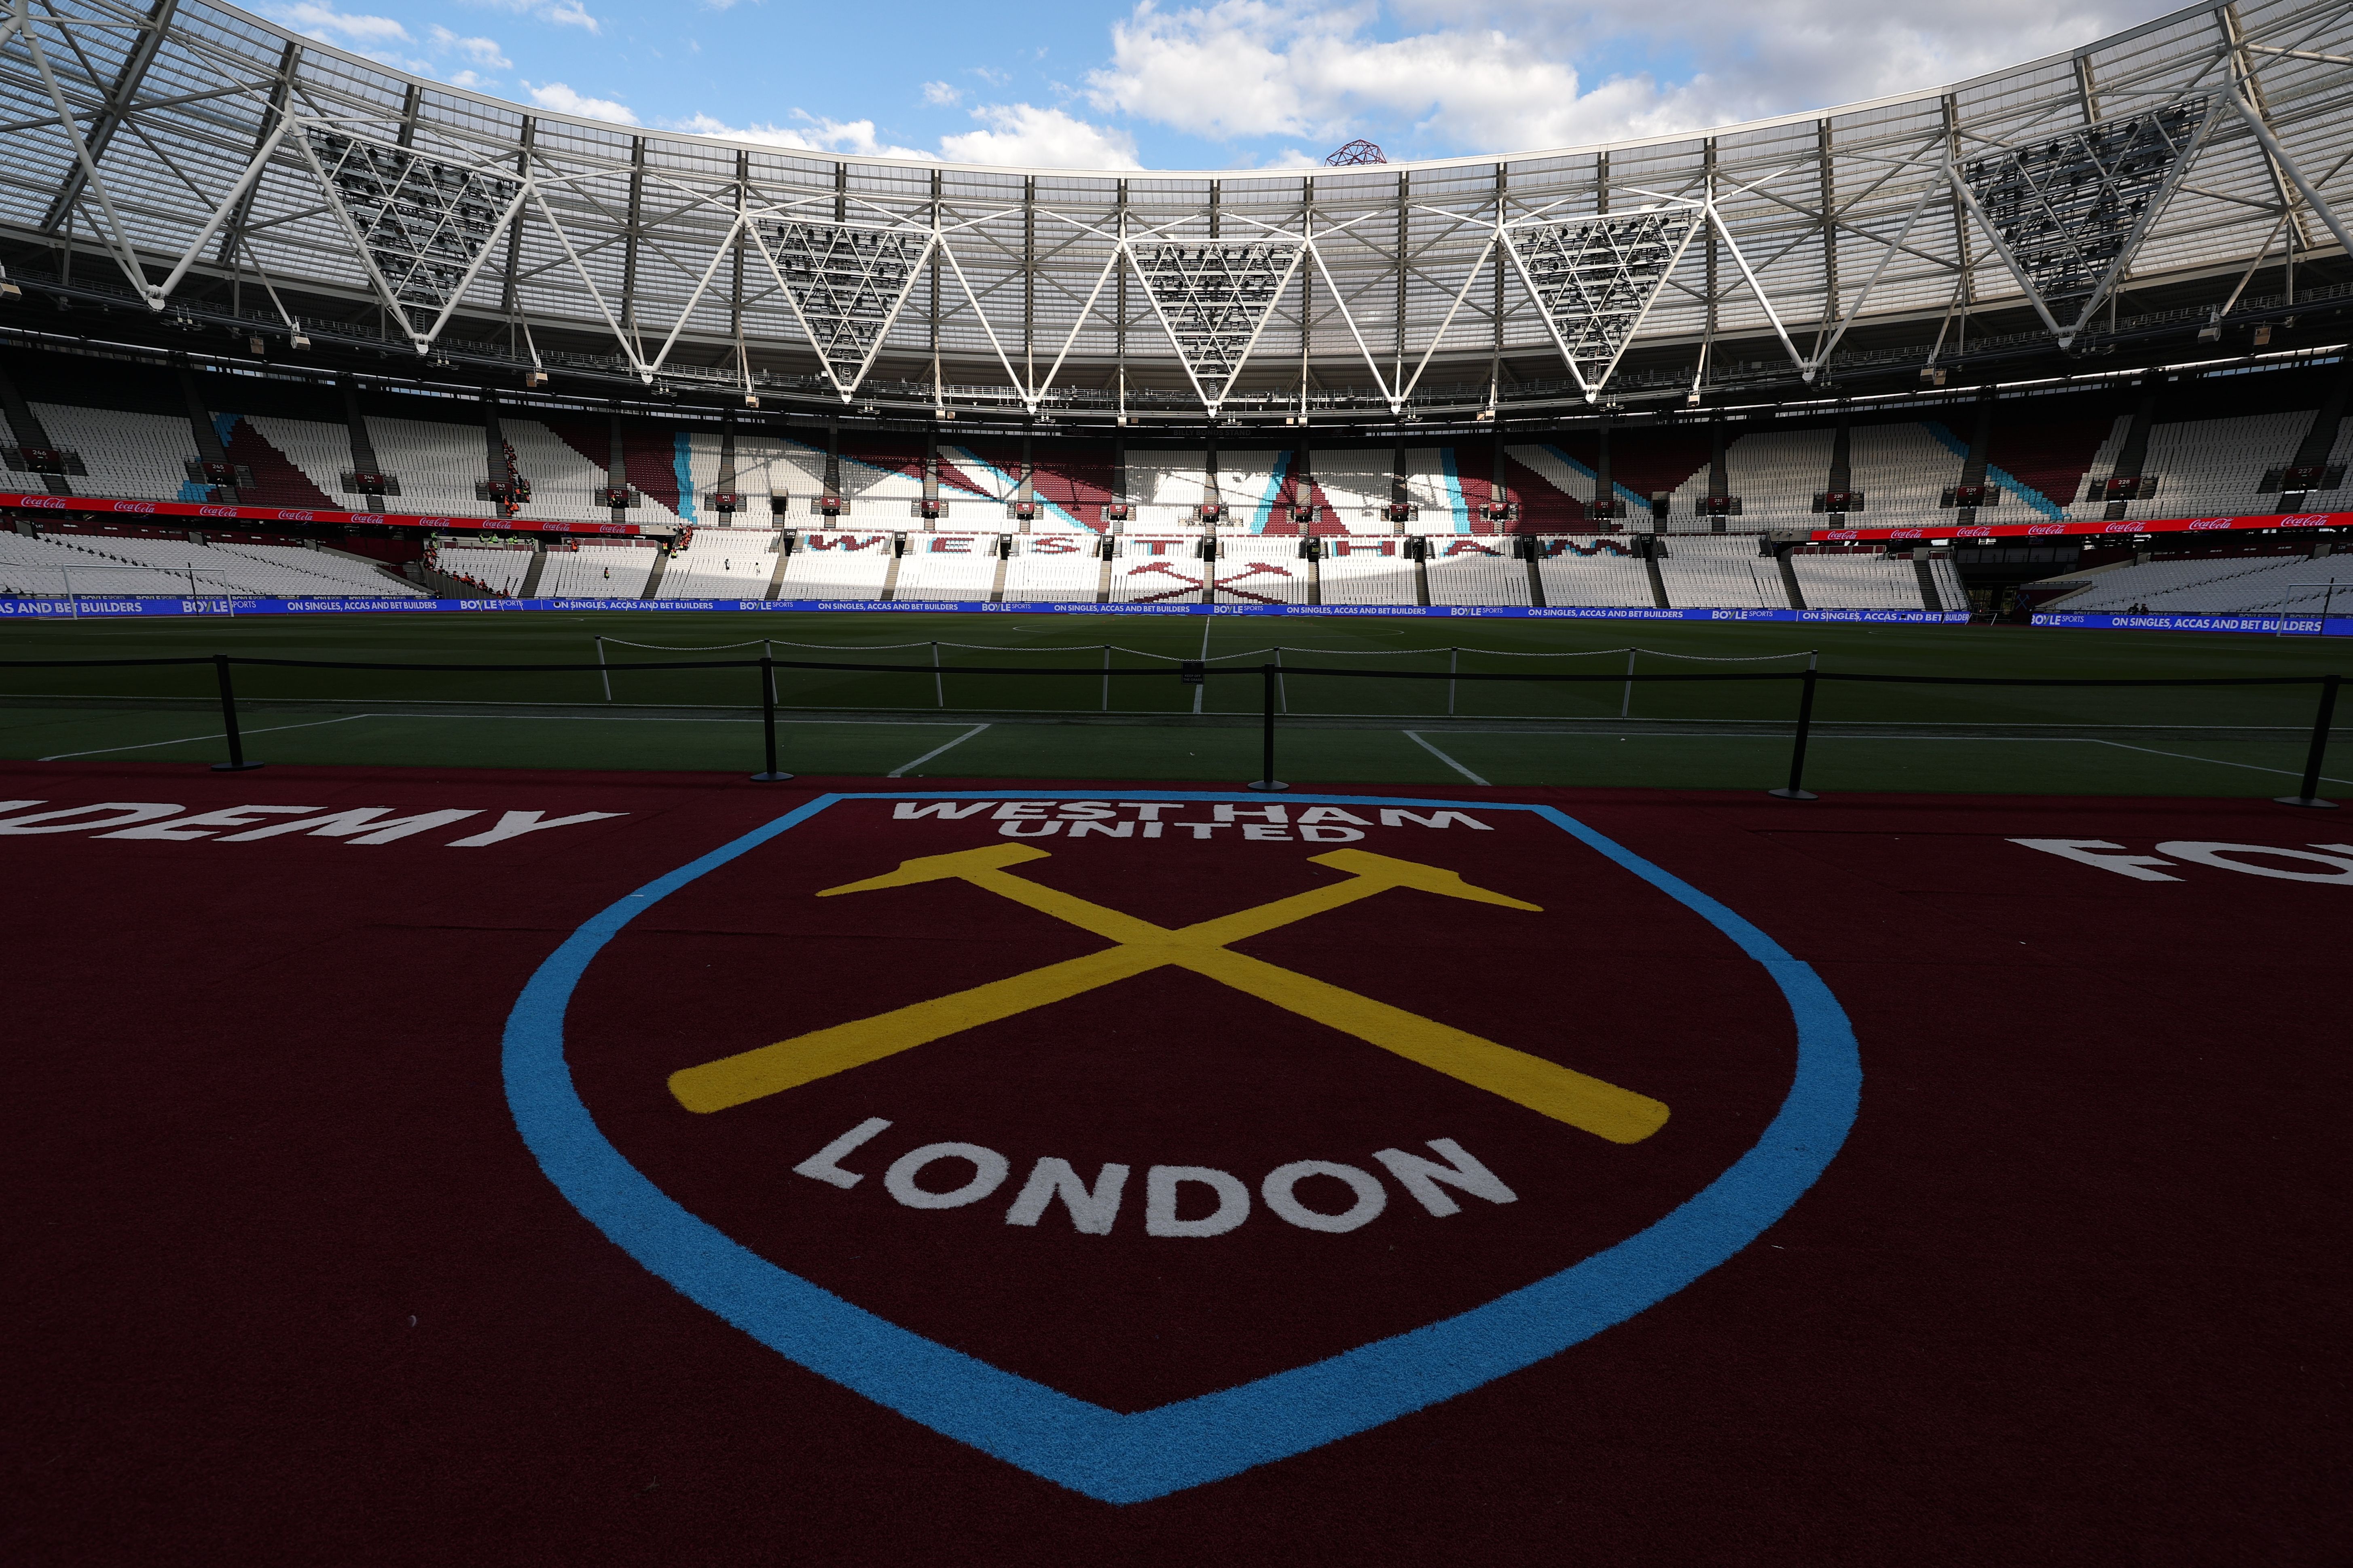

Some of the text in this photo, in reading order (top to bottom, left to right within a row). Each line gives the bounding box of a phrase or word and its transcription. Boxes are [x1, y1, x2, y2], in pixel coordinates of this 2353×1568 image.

[21, 497, 66, 508] Coca-Cola
[114, 501, 155, 513] Coca-Cola
[200, 506, 237, 517] Coca-Cola
[278, 510, 313, 521] Coca-Cola
[351, 514, 384, 524] Coca-Cola
[420, 517, 450, 527] Coca-Cola
[2189, 518, 2234, 530] Coca-Cola
[2281, 515, 2330, 527] Coca-Cola
[483, 520, 512, 529] Coca-Cola
[543, 522, 570, 531] Coca-Cola
[600, 524, 626, 533] Coca-Cola
[2028, 524, 2066, 535] Coca-Cola
[2106, 522, 2146, 533] Coca-Cola
[1828, 530, 1858, 540] Coca-Cola
[1891, 529, 1923, 539] Coca-Cola
[1957, 527, 1992, 537] Coca-Cola
[18, 603, 52, 613] AND
[81, 602, 142, 612] BUILDERS
[182, 601, 227, 613] BOYLE
[287, 602, 303, 611] ON
[305, 602, 343, 611] SINGLES,
[345, 602, 370, 610] ACCAS
[460, 600, 497, 609] BOYLE
[571, 602, 608, 610] SINGLES,
[740, 602, 771, 610] BOYLE
[982, 603, 1011, 611] BOYLE
[1214, 605, 1243, 613] BOYLE
[1451, 607, 1481, 616] BOYLE
[1543, 609, 1578, 617] SINGLES,
[1712, 611, 1747, 619] BOYLE
[1820, 613, 1862, 622] SINGLES,
[2031, 615, 2061, 625] BOYLE
[2112, 617, 2127, 626] ON
[2129, 618, 2172, 628] SINGLES,
[2174, 619, 2209, 628] ACCAS
[2211, 619, 2239, 629] AND
[2242, 620, 2261, 630] BET
[893, 801, 1494, 830] WEST HAM
[999, 820, 1365, 842] UNITED
[2005, 839, 2353, 885] FO
[793, 1118, 1517, 1237] LONDON
